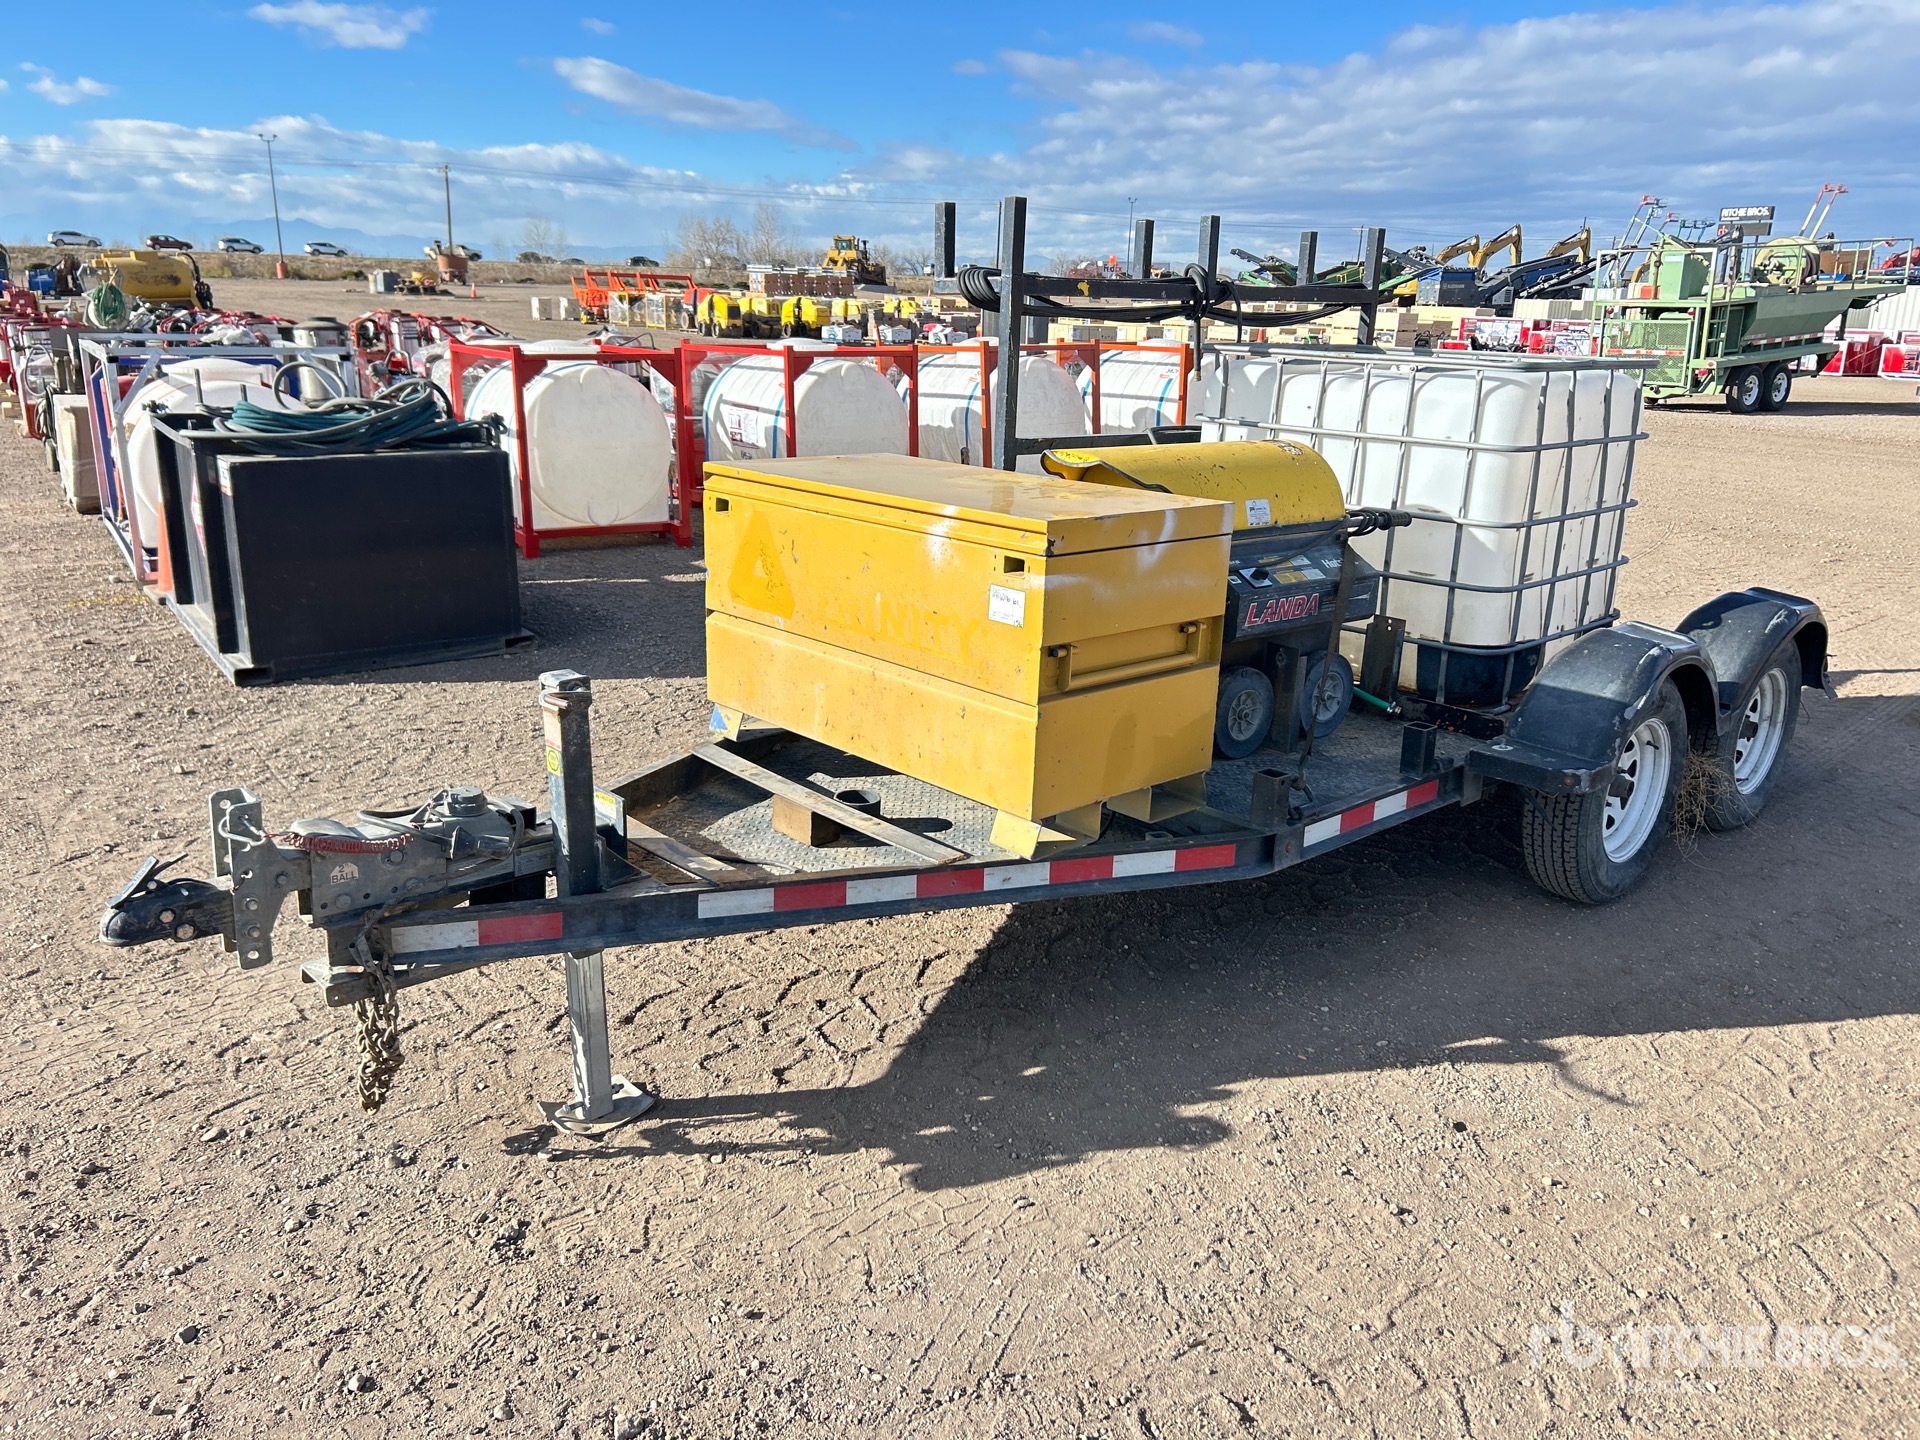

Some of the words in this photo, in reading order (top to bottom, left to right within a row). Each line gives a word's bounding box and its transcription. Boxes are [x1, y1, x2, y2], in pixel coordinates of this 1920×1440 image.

[1721, 208, 1747, 217] RITCHIE
[1245, 593, 1319, 626] LANDA
[331, 870, 357, 883] BALL
